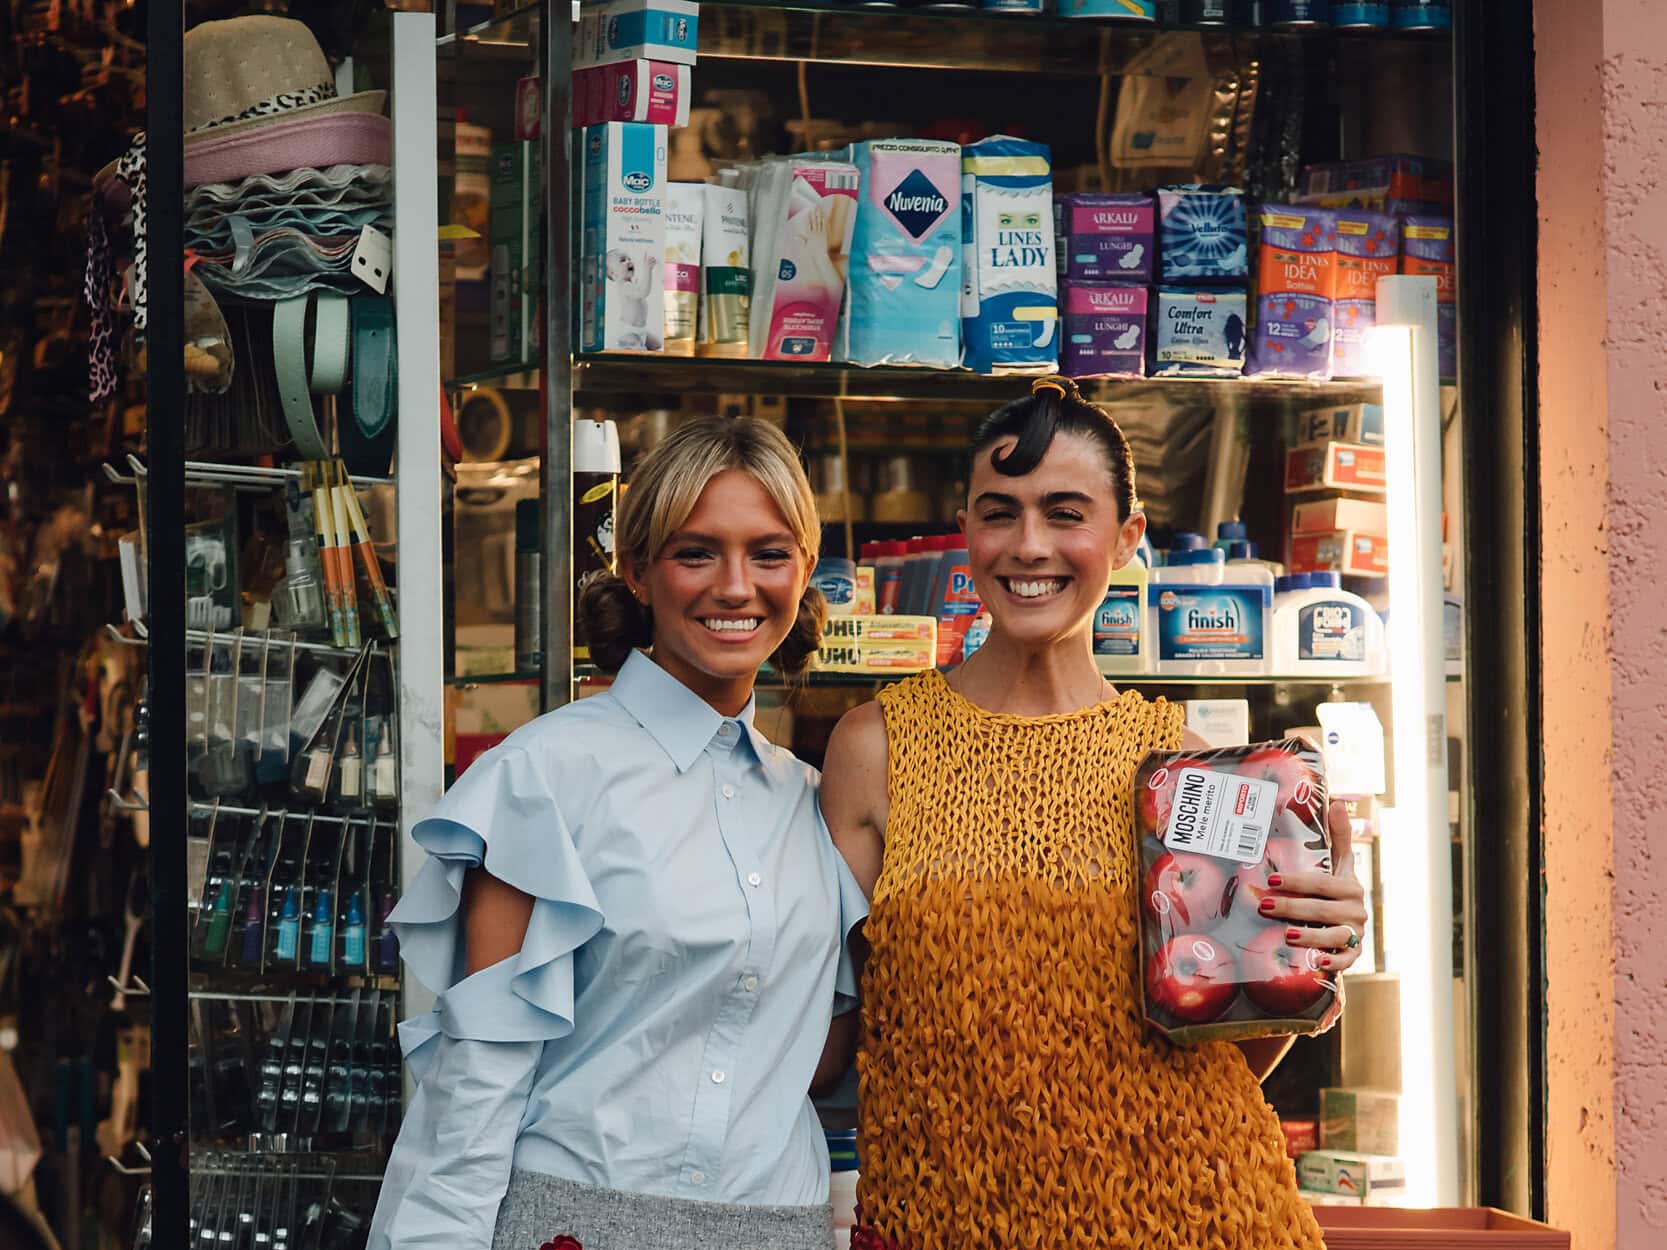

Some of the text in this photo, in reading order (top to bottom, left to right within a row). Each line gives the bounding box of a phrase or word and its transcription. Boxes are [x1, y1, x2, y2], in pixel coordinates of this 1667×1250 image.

[623, 174, 650, 187] Mac
[889, 191, 944, 213] Nuvenia
[998, 231, 1043, 246] LINES
[991, 247, 1049, 267] LADY
[1299, 255, 1329, 267] LINES
[1284, 263, 1317, 280] IDEA
[1168, 305, 1213, 322] Comfort
[993, 324, 1006, 335] 10
[1173, 321, 1204, 335] Ultra
[1267, 322, 1281, 336] 12
[1161, 350, 1172, 360] 10
[1101, 610, 1133, 625] finish
[1188, 609, 1235, 629] finish
[1172, 773, 1206, 845] MOSCHINO
[1195, 783, 1217, 841] Mele merito
